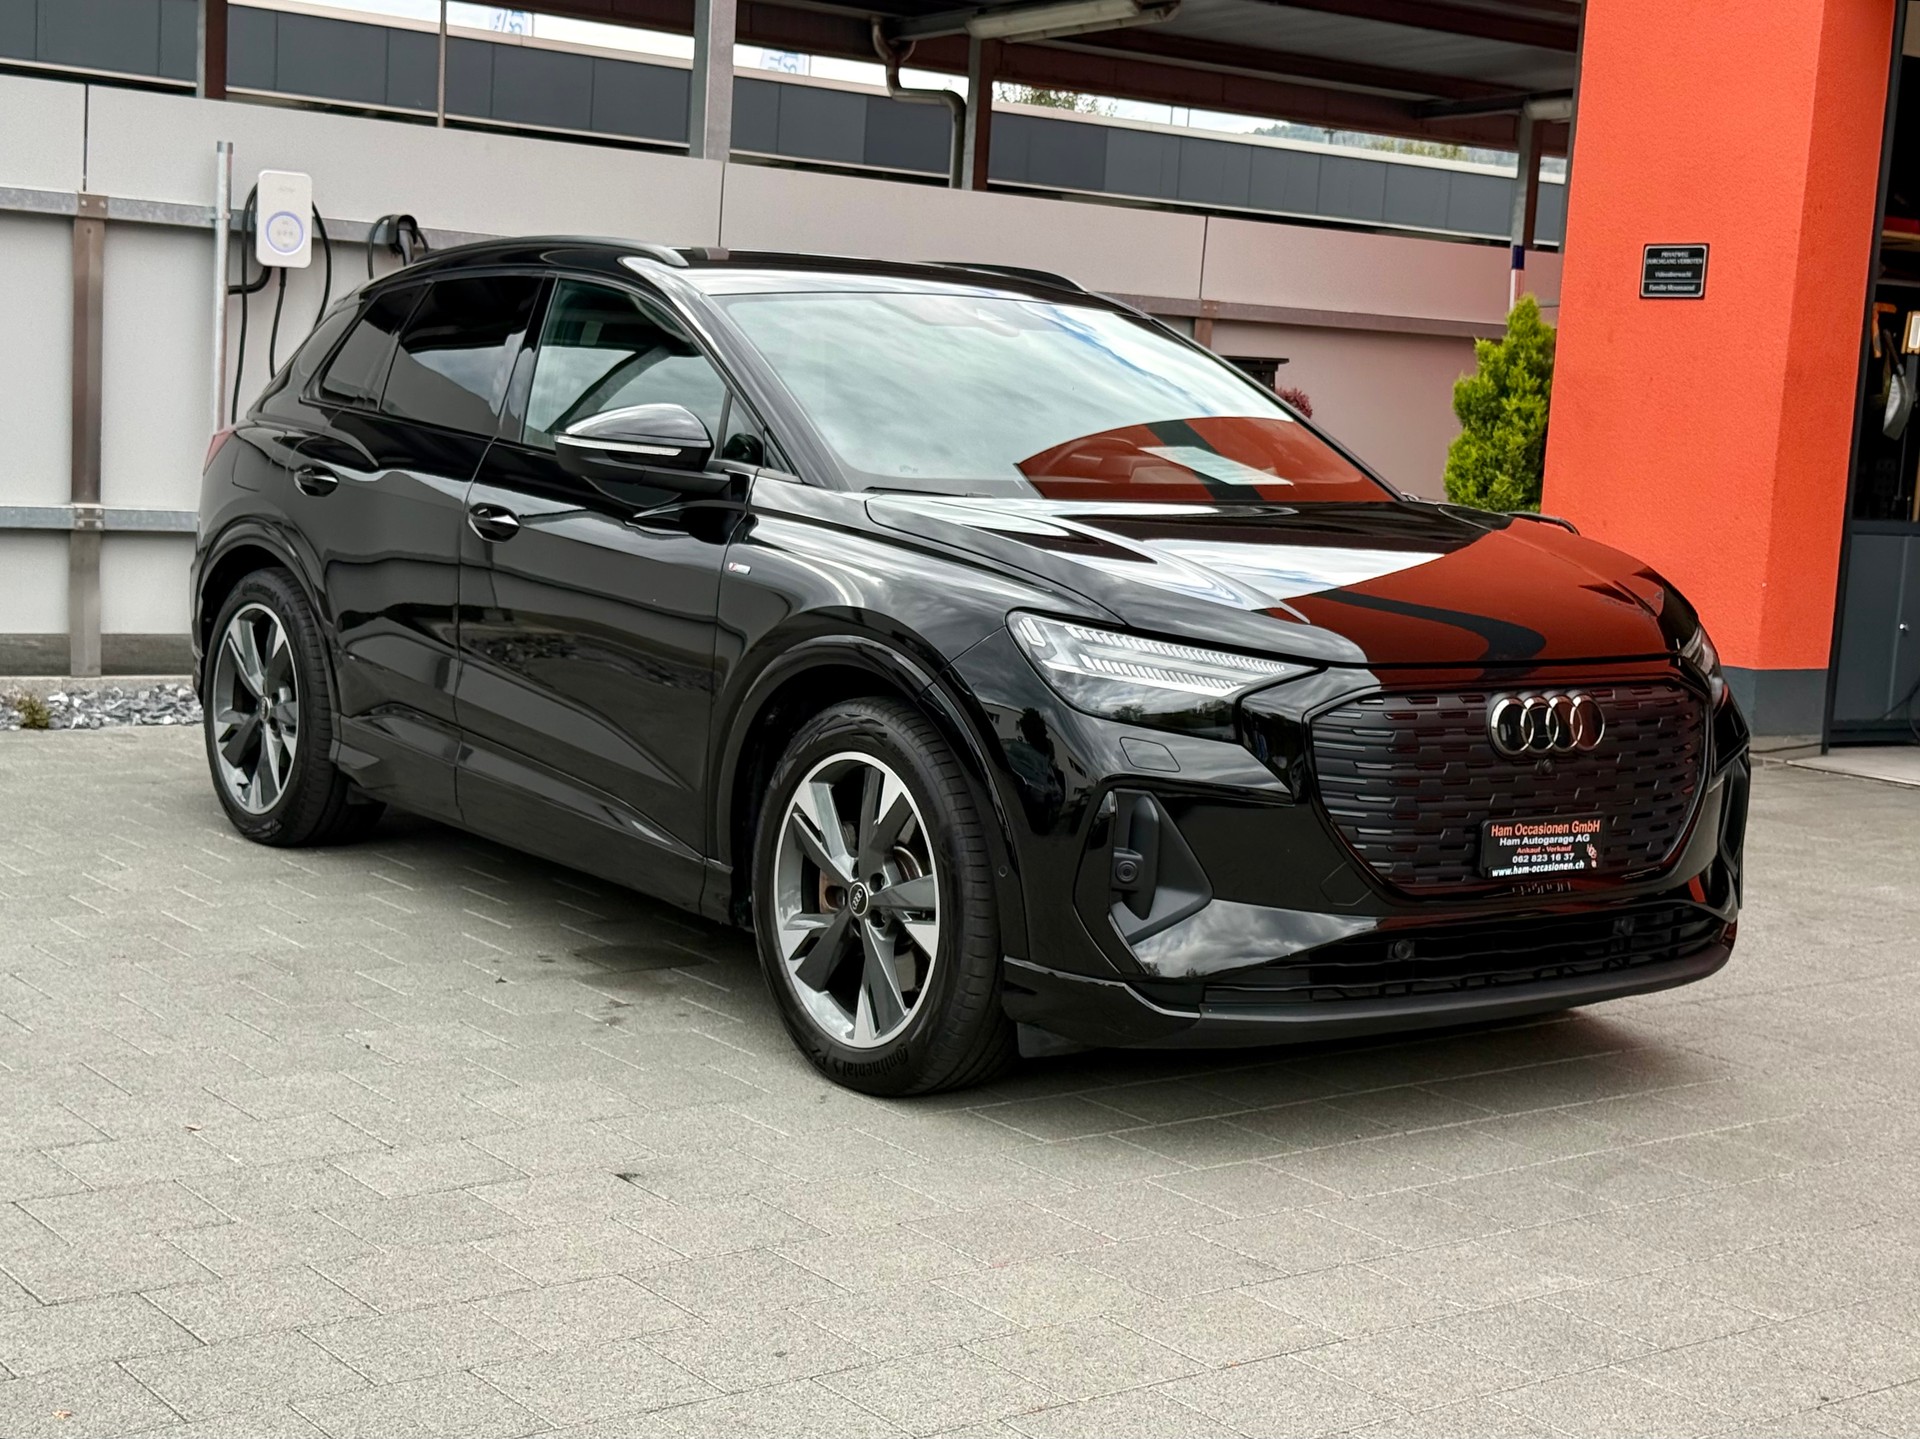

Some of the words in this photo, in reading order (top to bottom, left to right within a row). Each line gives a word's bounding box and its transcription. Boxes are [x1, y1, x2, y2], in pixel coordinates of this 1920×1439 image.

[1491, 824, 1513, 837] Ham
[1514, 821, 1569, 836] Occasionen
[1571, 819, 1600, 834] GmbH
[1499, 837, 1520, 846] Ham
[1521, 834, 1575, 846] Autogarage
[1575, 833, 1590, 843] AG
[1516, 846, 1541, 854] Ankauf
[1546, 845, 1572, 853] Verkauf
[1512, 854, 1528, 864] 062
[1531, 853, 1548, 863] 823
[1564, 852, 1575, 861] 37
[1491, 859, 1585, 877] www.ham-occasionen.ch
[842, 1043, 909, 1079] Continental
